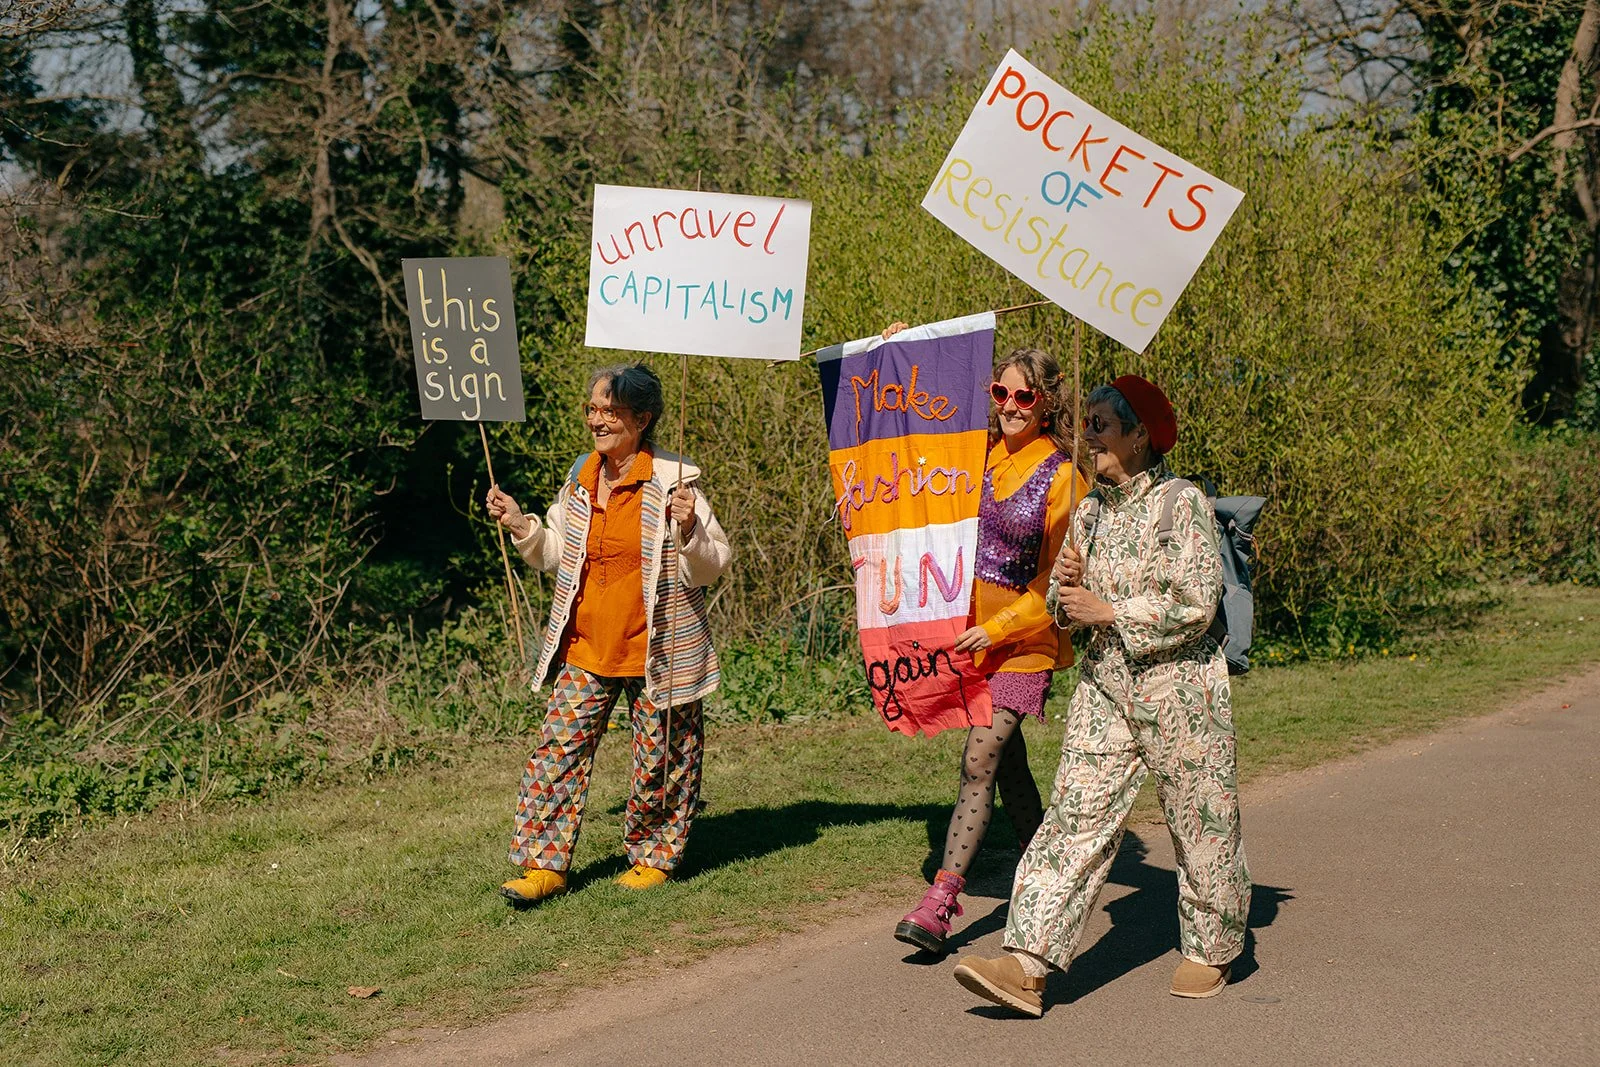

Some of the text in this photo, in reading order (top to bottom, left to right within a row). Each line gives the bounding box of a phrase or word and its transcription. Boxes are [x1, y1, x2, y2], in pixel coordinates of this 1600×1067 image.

[986, 65, 1214, 232] POCKETS
[1041, 170, 1104, 213] OF
[596, 203, 786, 265] unravel
[933, 157, 1163, 327] Resistance
[417, 267, 501, 333] this
[599, 270, 794, 324] CAPITALISM
[421, 332, 491, 366] is a
[424, 365, 507, 421] sign
[851, 364, 959, 424] Make
[836, 451, 977, 531] fashion
[853, 545, 964, 616] UN
[863, 640, 963, 722] gain
